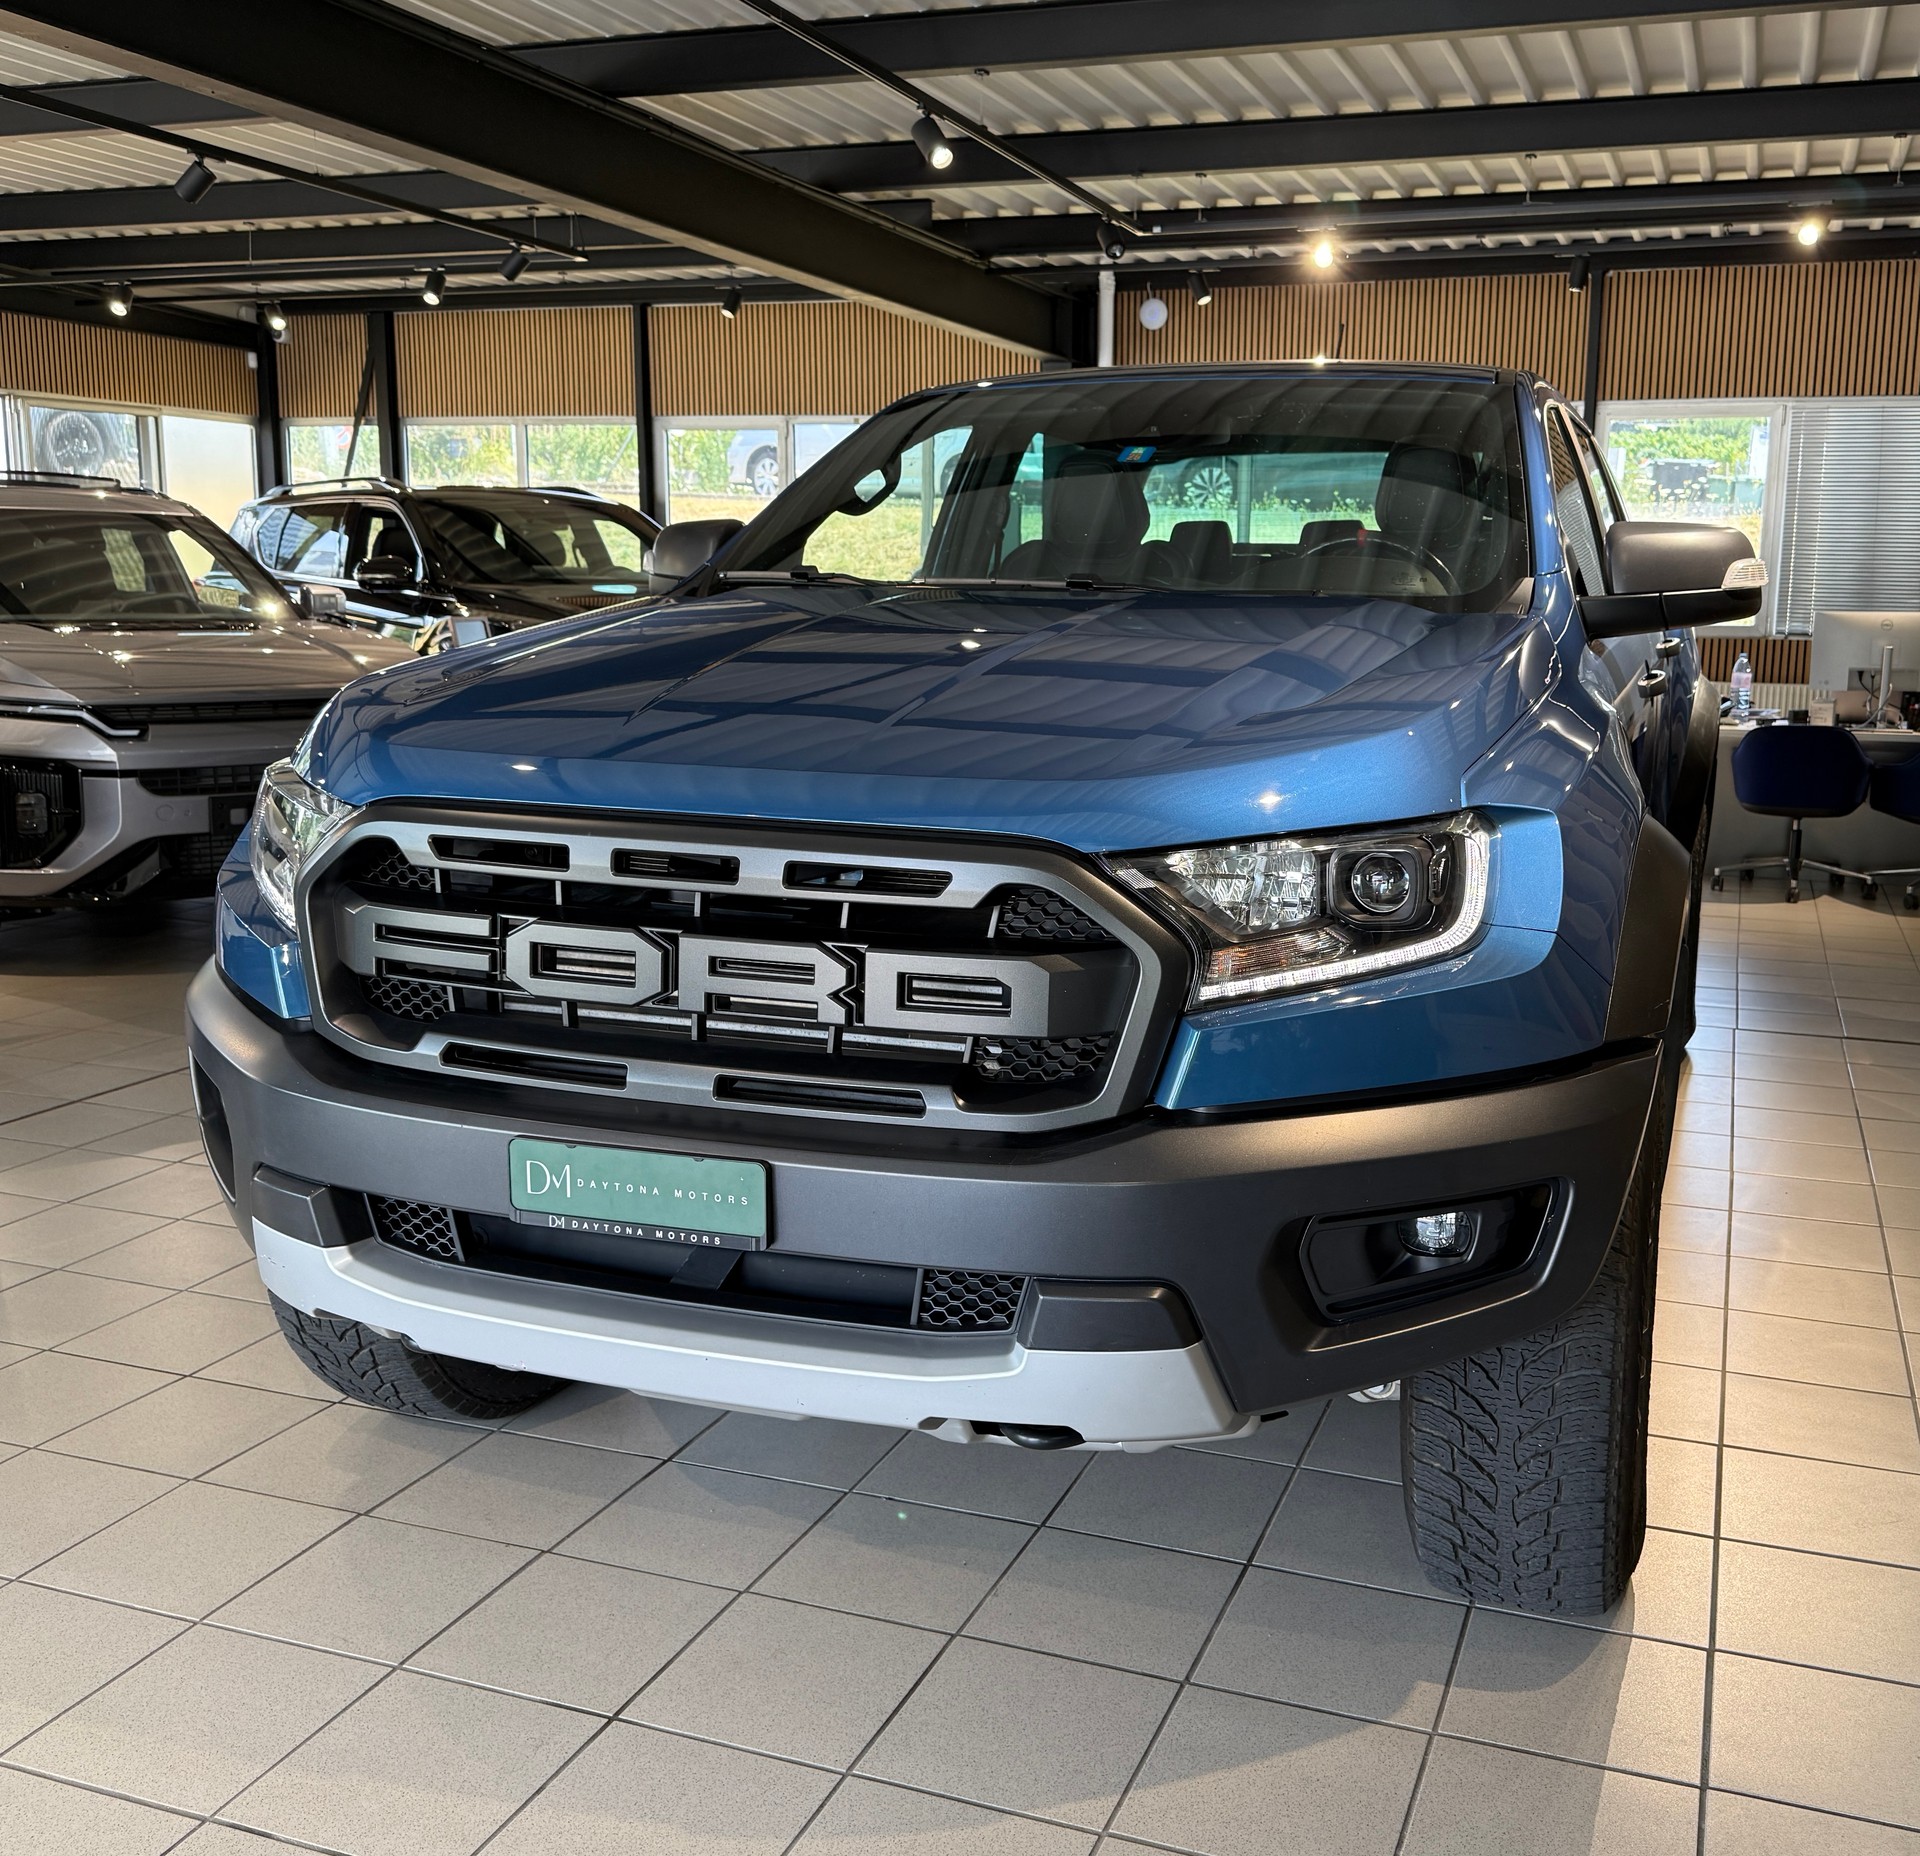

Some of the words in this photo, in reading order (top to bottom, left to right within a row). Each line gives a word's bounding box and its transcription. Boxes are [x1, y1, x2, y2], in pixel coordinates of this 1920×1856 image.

[340, 902, 1050, 1038] FORD
[525, 1159, 571, 1198] DM
[577, 1178, 659, 1196] DAYTONA
[674, 1188, 748, 1205] MOTORS
[572, 1220, 643, 1236] DAYTONA
[655, 1230, 721, 1245] MOTORS
